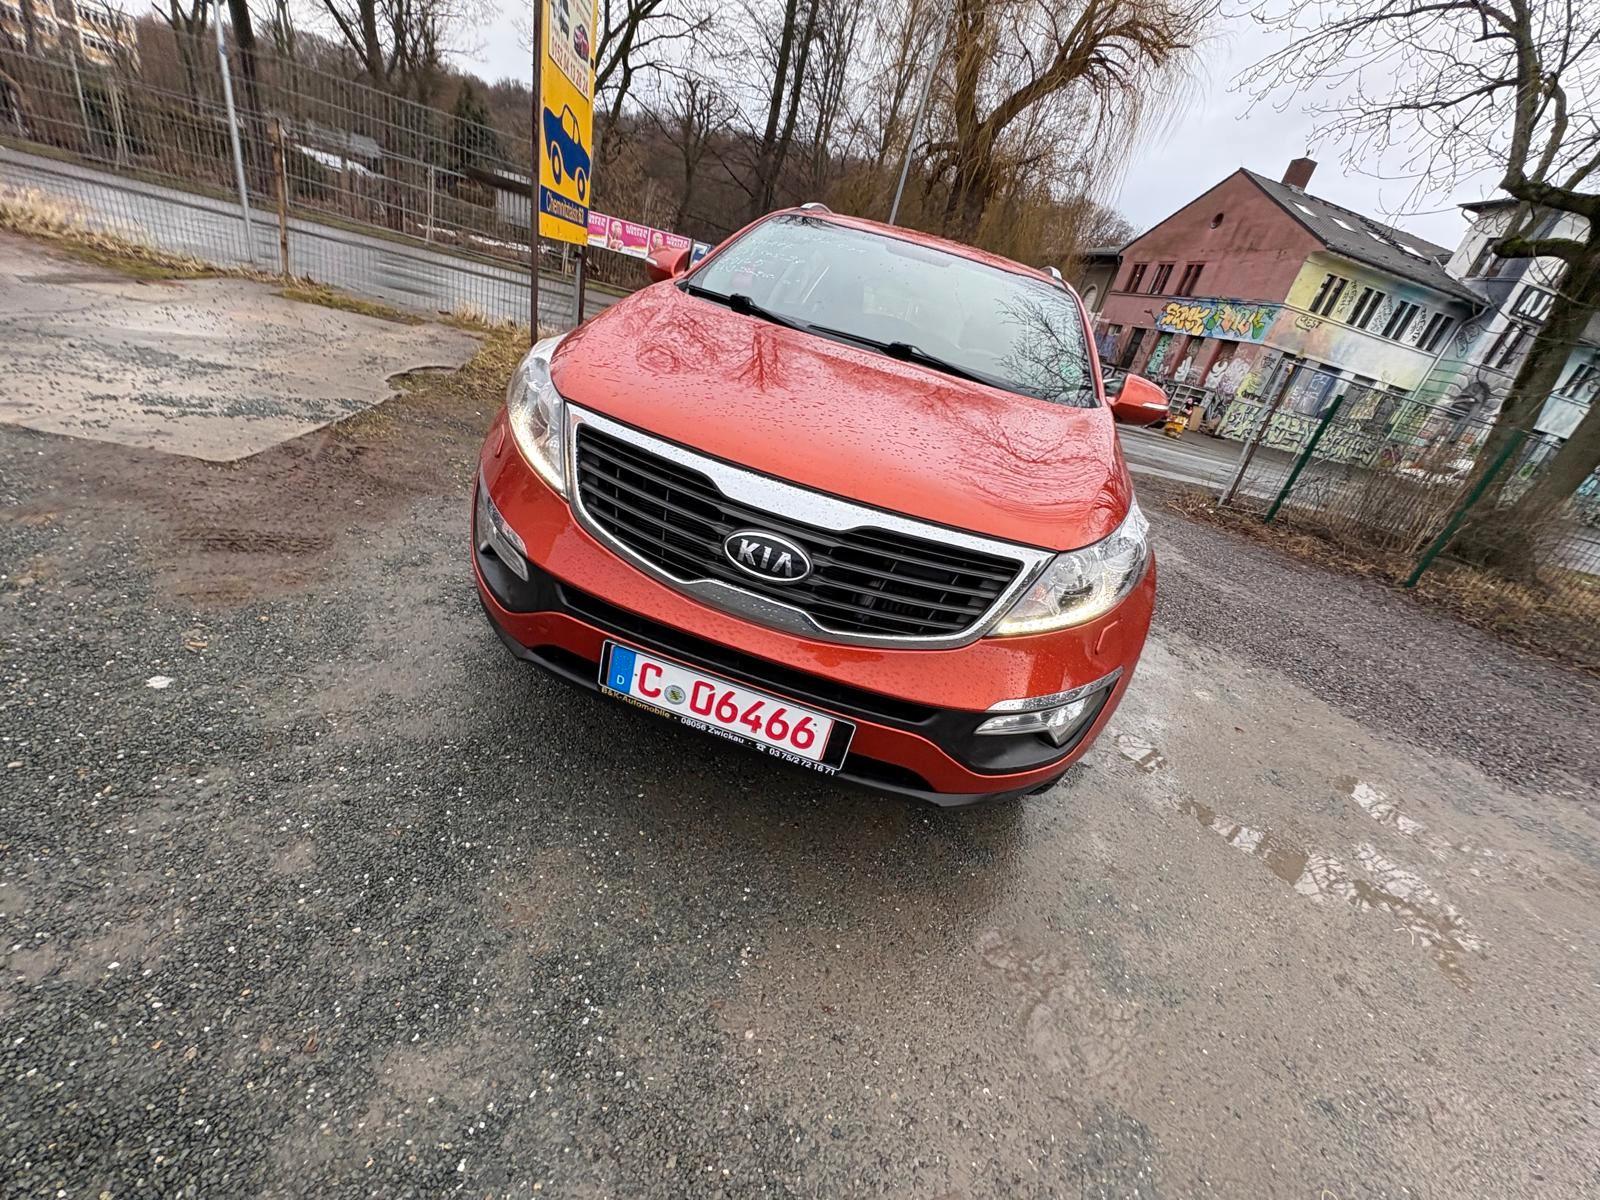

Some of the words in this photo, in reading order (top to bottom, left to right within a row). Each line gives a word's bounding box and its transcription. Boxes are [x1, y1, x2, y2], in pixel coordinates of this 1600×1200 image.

[738, 538, 792, 577] KIA
[616, 674, 625, 685] D
[602, 686, 670, 718] B&K-Automobile
[681, 717, 706, 731] 08056
[708, 725, 744, 744] Zwickau
[638, 662, 663, 698] C
[689, 680, 815, 749] 06466
